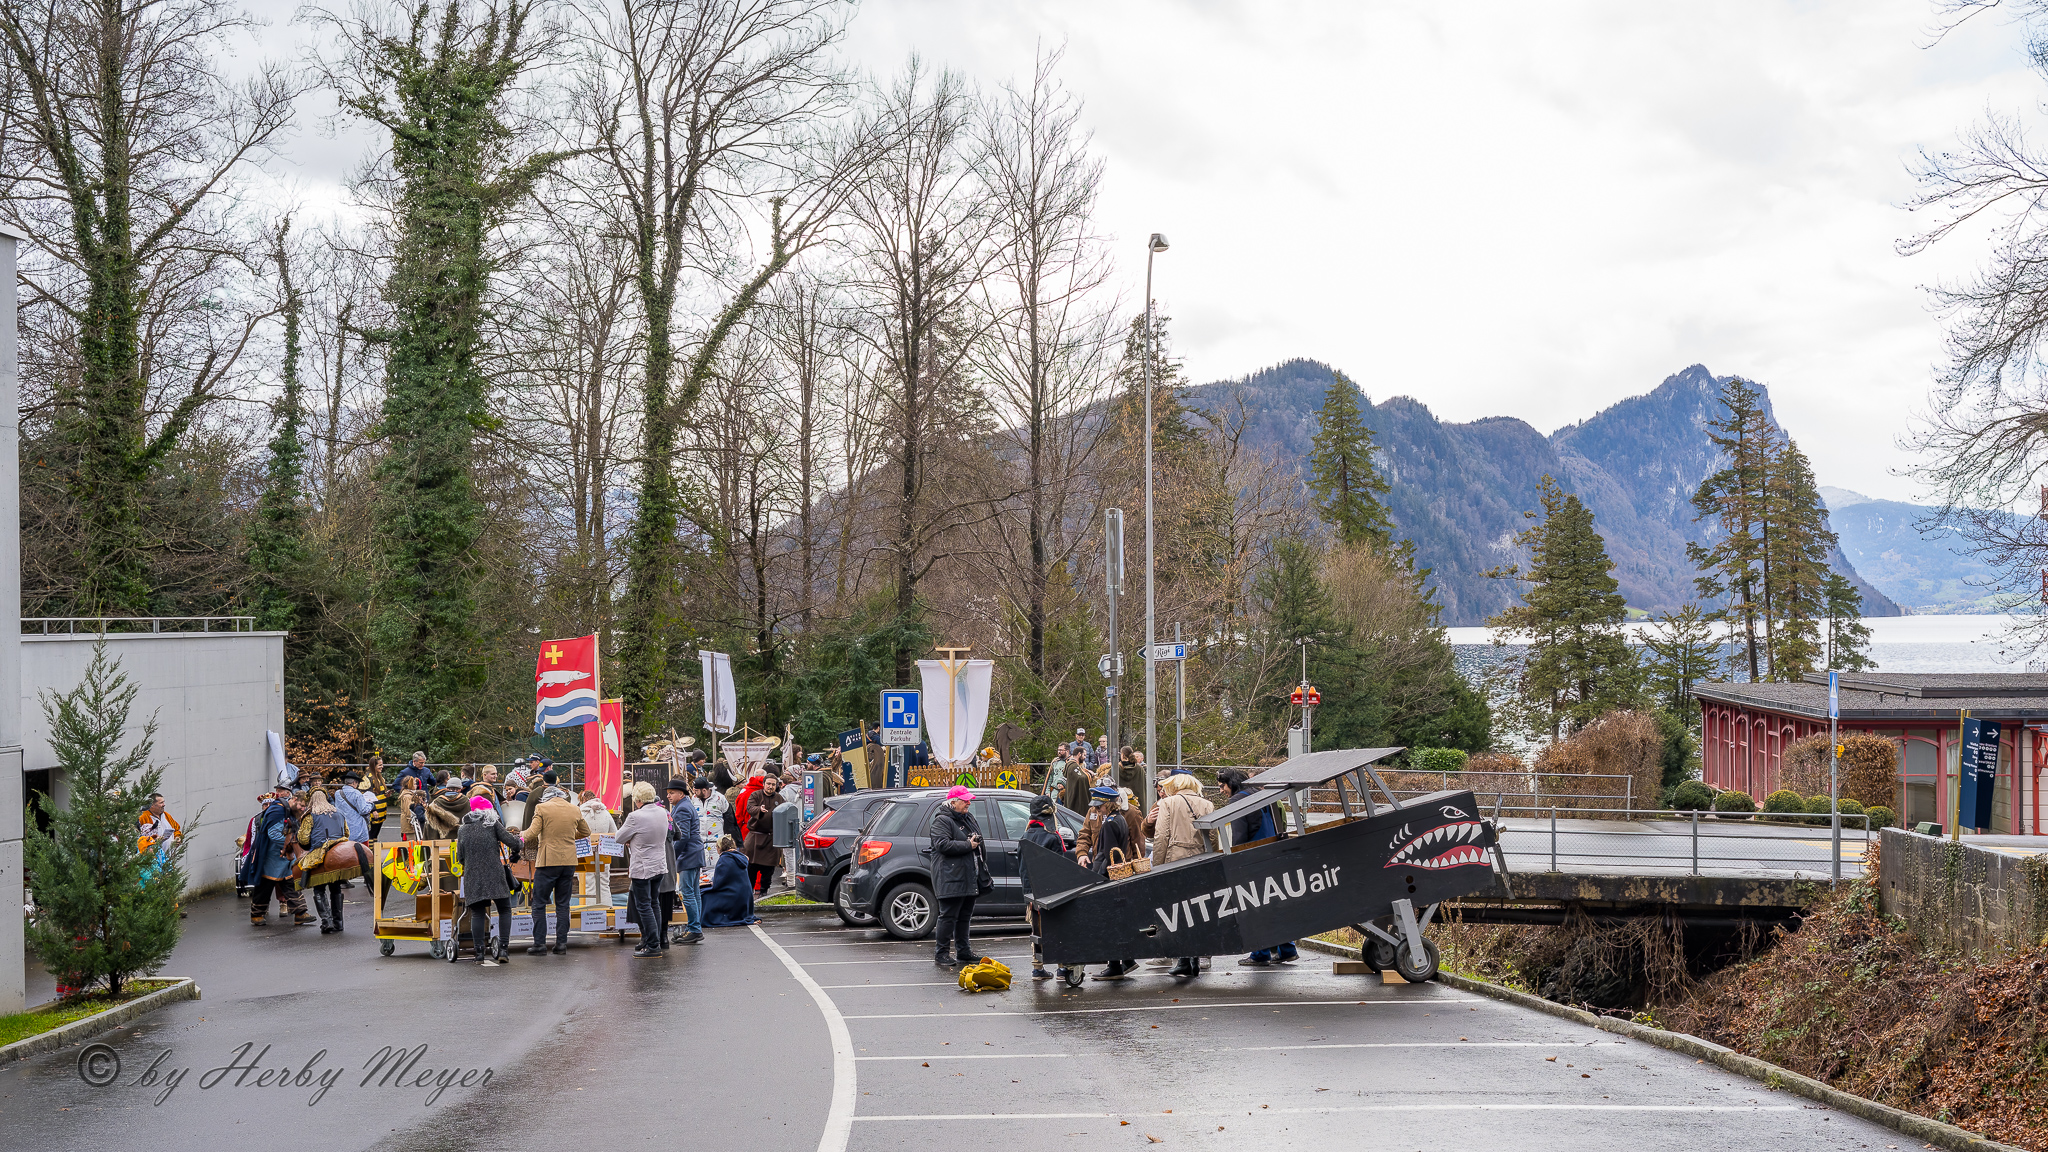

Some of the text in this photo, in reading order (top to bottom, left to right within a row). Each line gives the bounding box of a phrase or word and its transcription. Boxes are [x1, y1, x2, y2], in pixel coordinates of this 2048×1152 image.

[1155, 646, 1171, 658] Rigi
[888, 696, 904, 722] P
[805, 775, 814, 788] P
